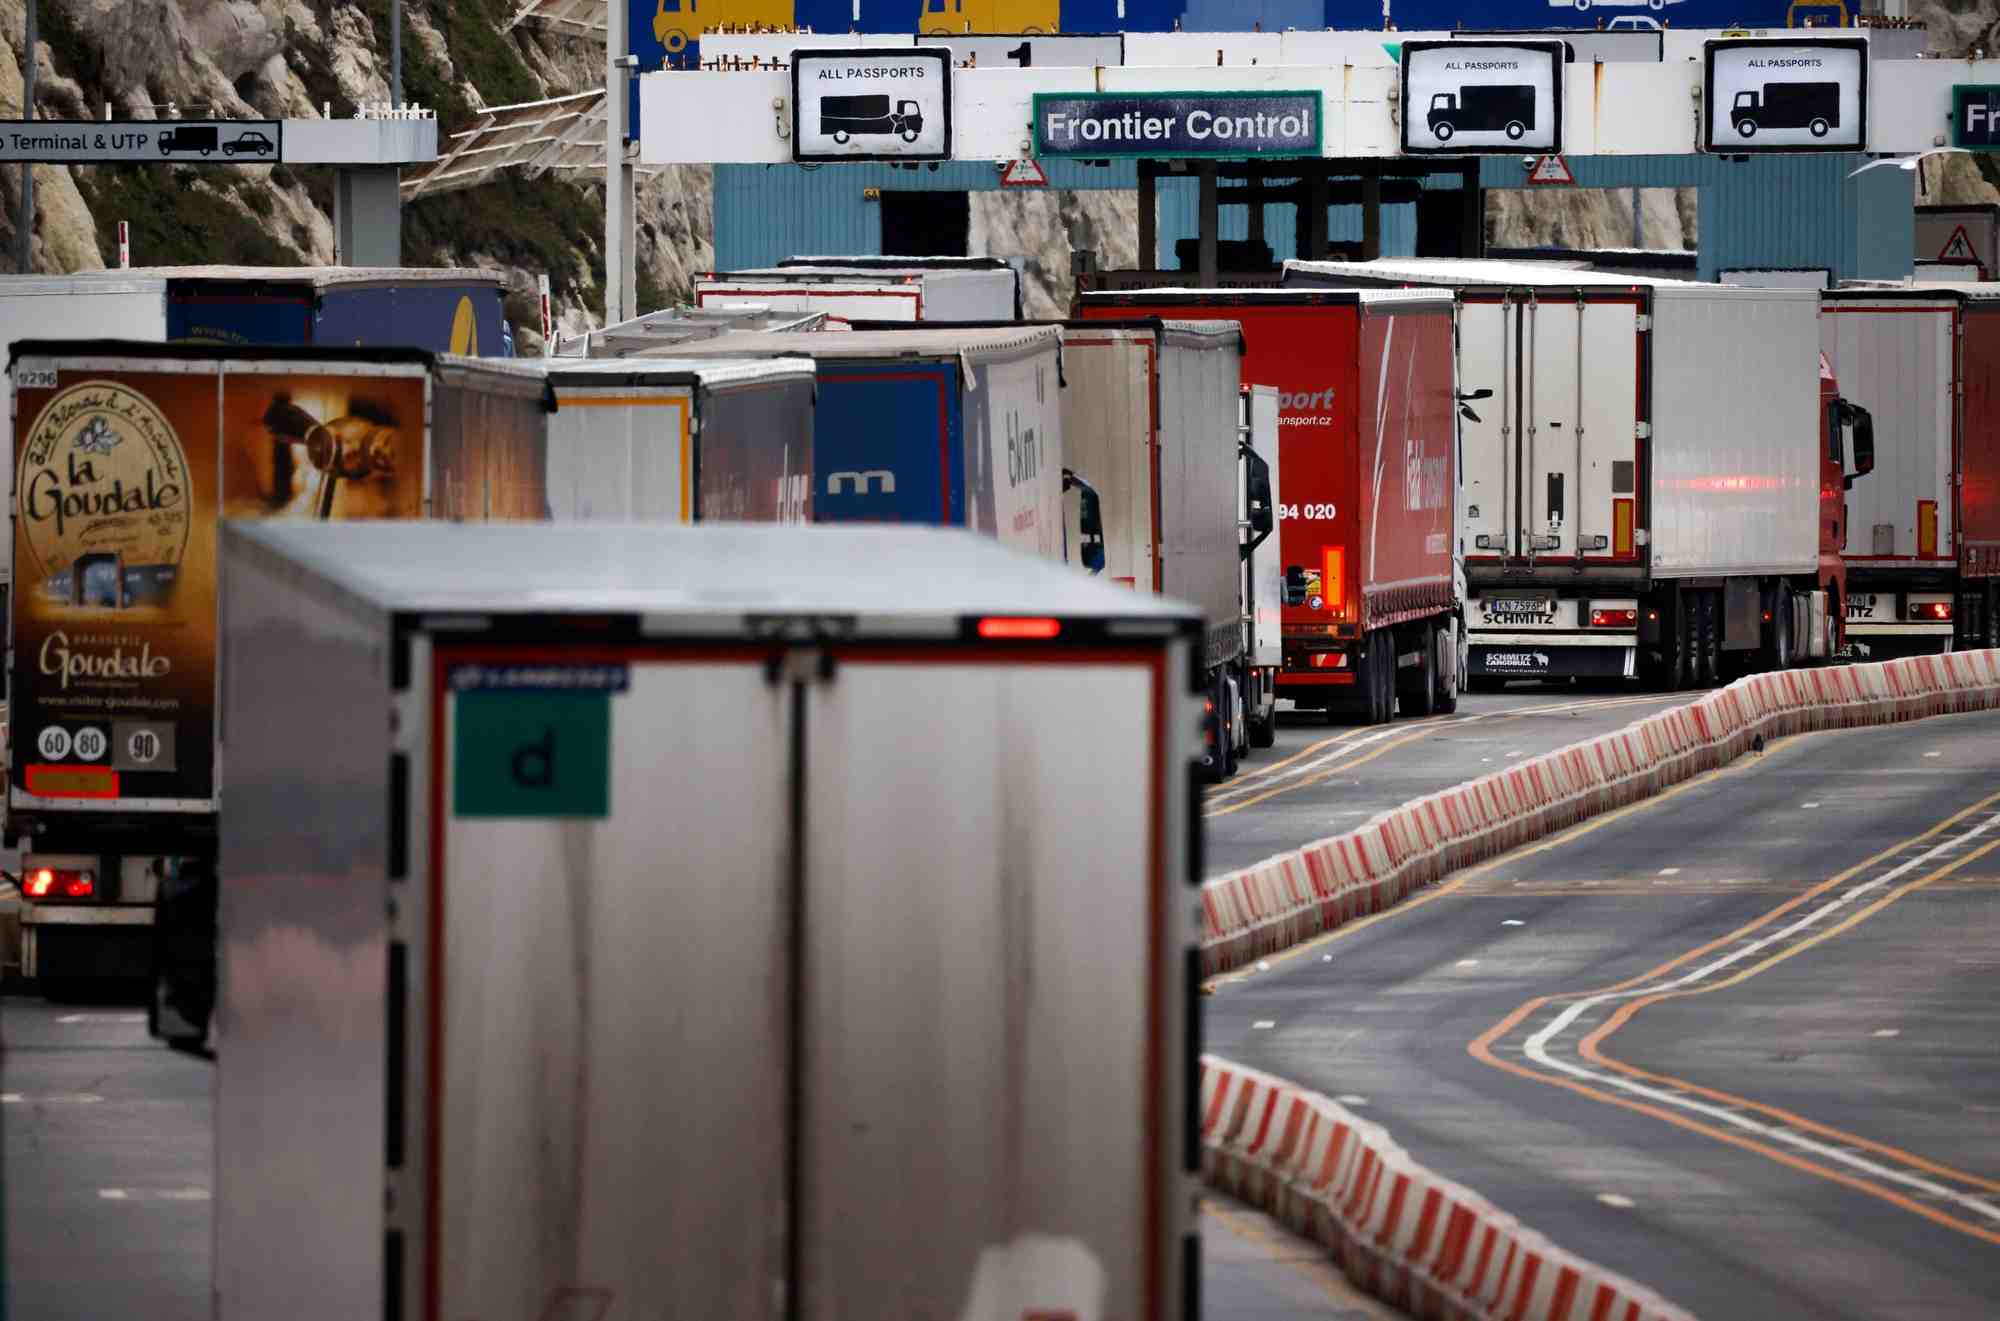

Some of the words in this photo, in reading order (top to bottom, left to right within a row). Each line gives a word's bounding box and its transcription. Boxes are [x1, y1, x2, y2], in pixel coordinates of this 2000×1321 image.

[1445, 62, 1461, 70] ALL
[1464, 62, 1519, 70] PASSPORTS
[1768, 59, 1822, 68] PASSPORTS
[819, 69, 843, 80] ALL
[847, 67, 924, 79] PASSPORTS
[1047, 111, 1176, 141] Frontier
[1186, 110, 1309, 139] Control
[10, 133, 88, 150] Terminal
[93, 134, 105, 150] &
[111, 133, 148, 150] UTP
[68, 450, 104, 487] la
[28, 468, 182, 537] Goudale
[1303, 503, 1336, 520] 020
[1483, 614, 1553, 625] SCHMITZ
[40, 630, 171, 689] Goudale
[44, 733, 64, 752] 60
[79, 733, 100, 753] 80
[134, 735, 154, 759] 90
